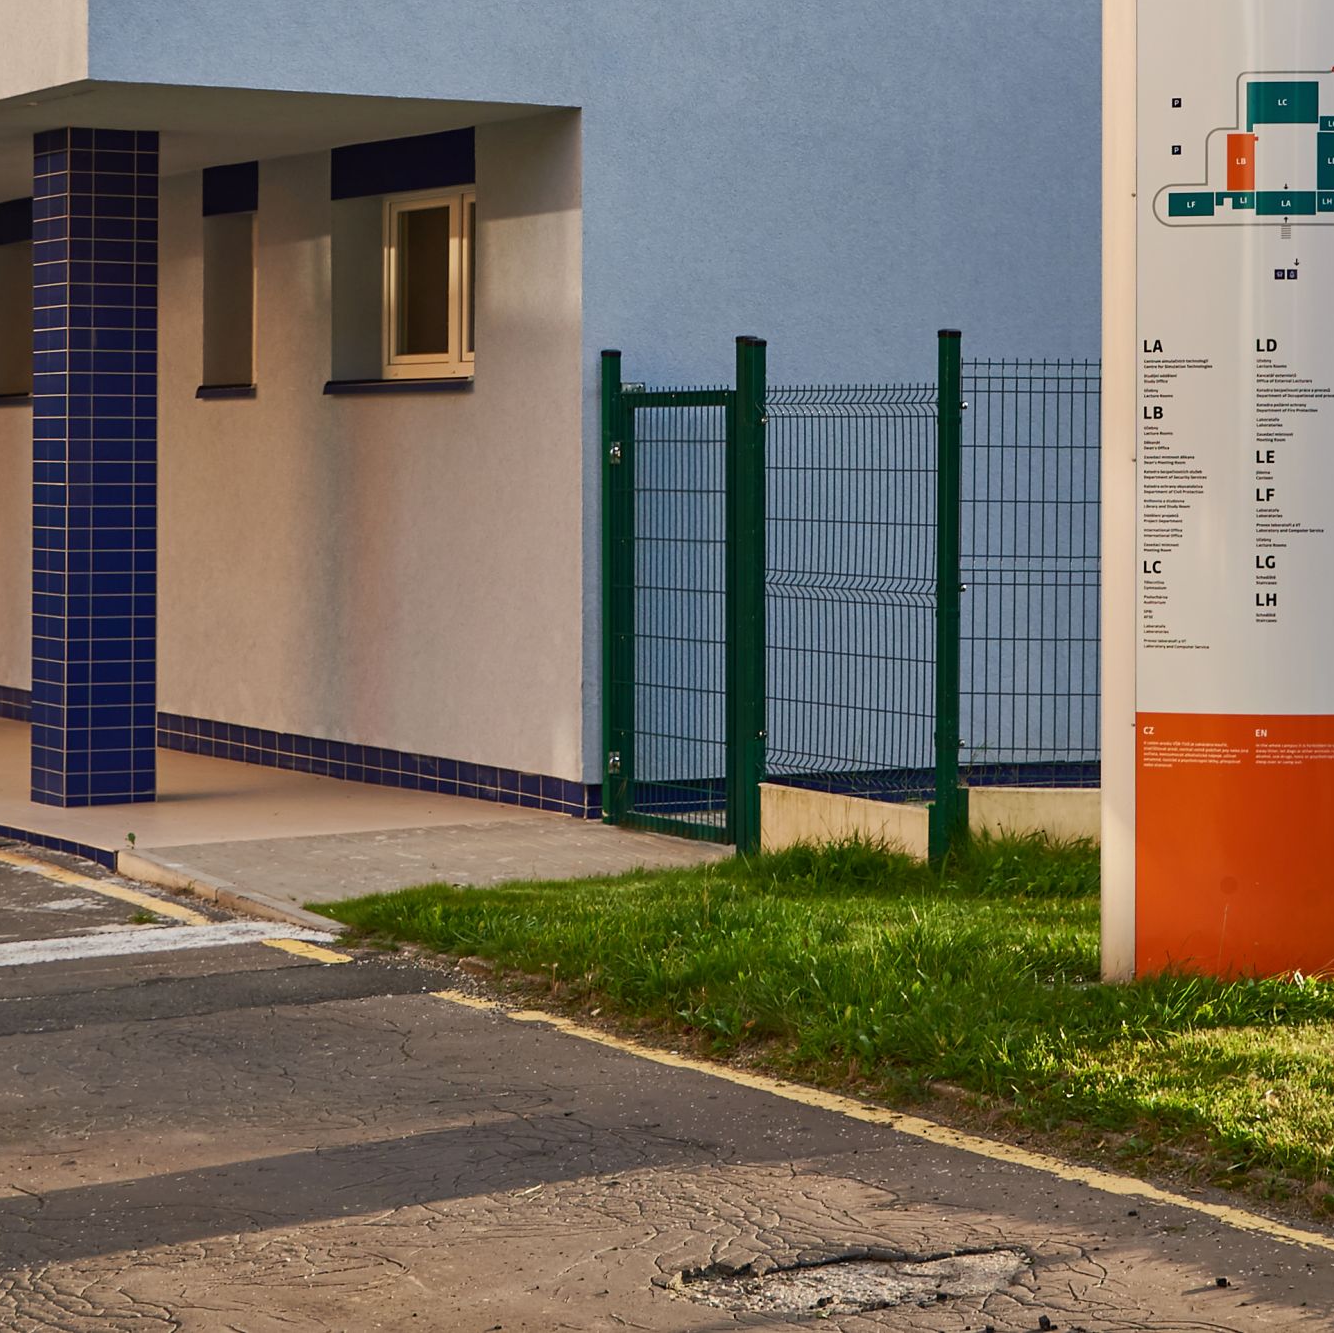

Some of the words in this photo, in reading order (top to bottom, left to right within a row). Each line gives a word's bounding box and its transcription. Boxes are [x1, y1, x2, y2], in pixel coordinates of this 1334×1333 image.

[1144, 340, 1163, 352] LA
[1256, 339, 1277, 352] LD
[1144, 406, 1163, 419] LB
[1256, 450, 1275, 463] LE
[1256, 488, 1275, 501] LF
[1144, 561, 1161, 574] LC
[1256, 556, 1276, 569] LG
[1256, 593, 1277, 606] LH
[1144, 726, 1154, 734] CZ
[1255, 729, 1267, 737] EN
